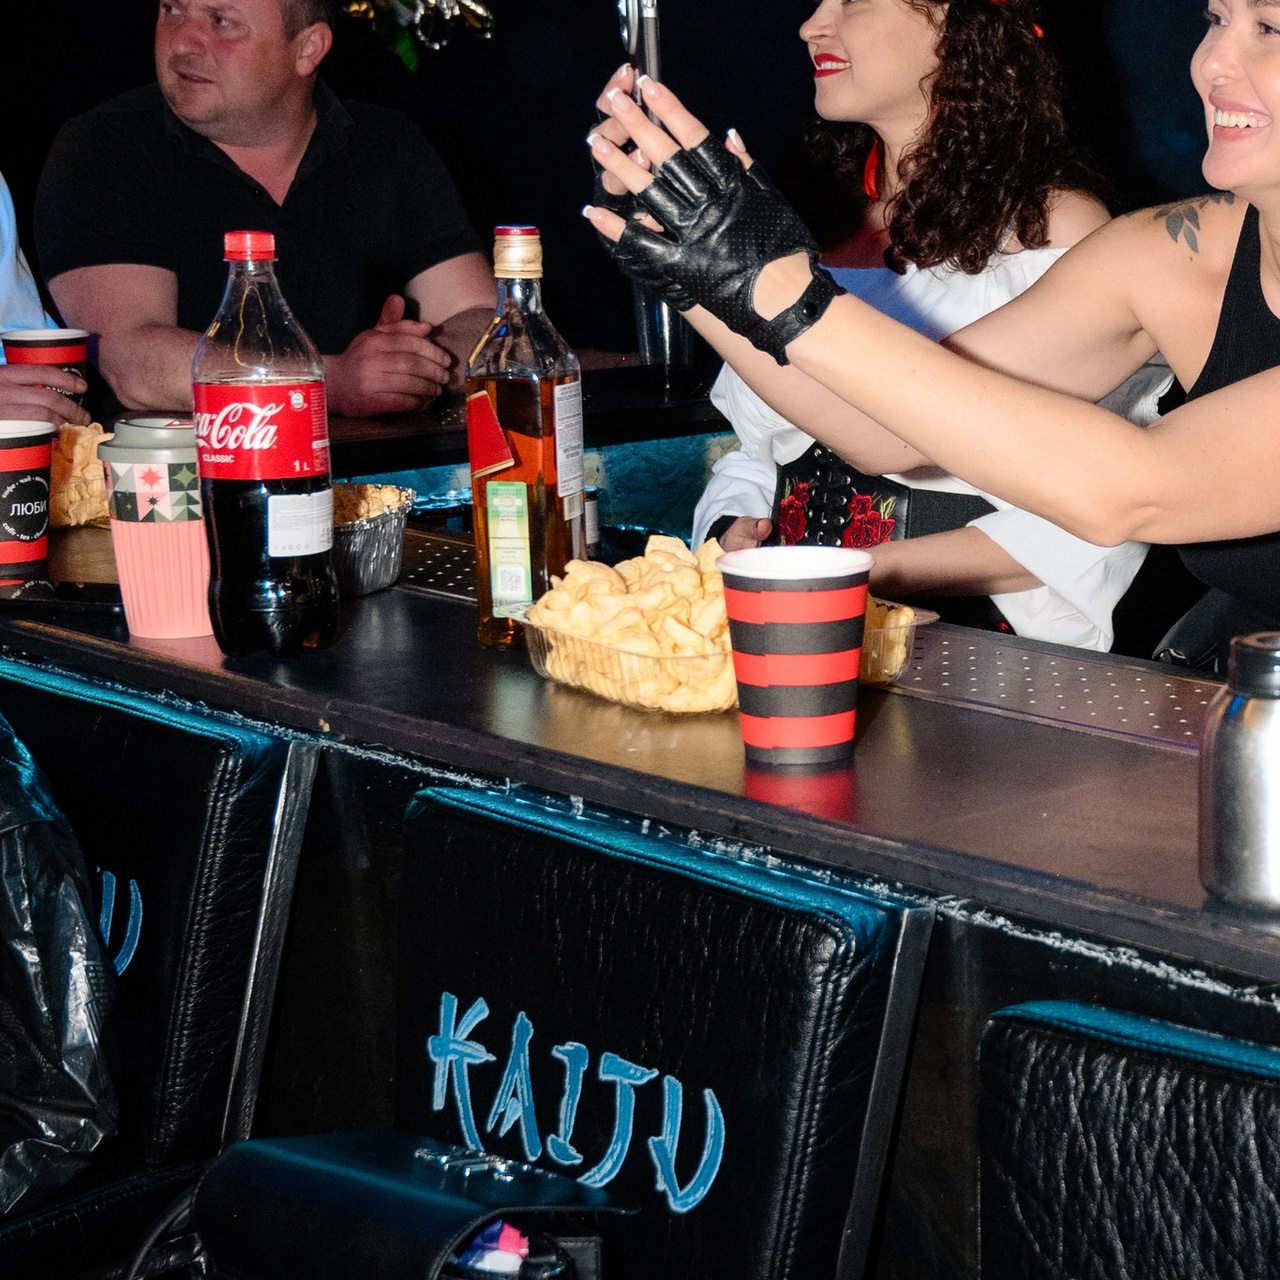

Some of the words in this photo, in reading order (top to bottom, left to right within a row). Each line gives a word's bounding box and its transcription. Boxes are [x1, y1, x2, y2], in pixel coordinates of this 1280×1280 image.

[195, 402, 286, 450] ca-Cola
[202, 453, 235, 464] CLASSIC
[427, 991, 725, 1213] KAIJU
